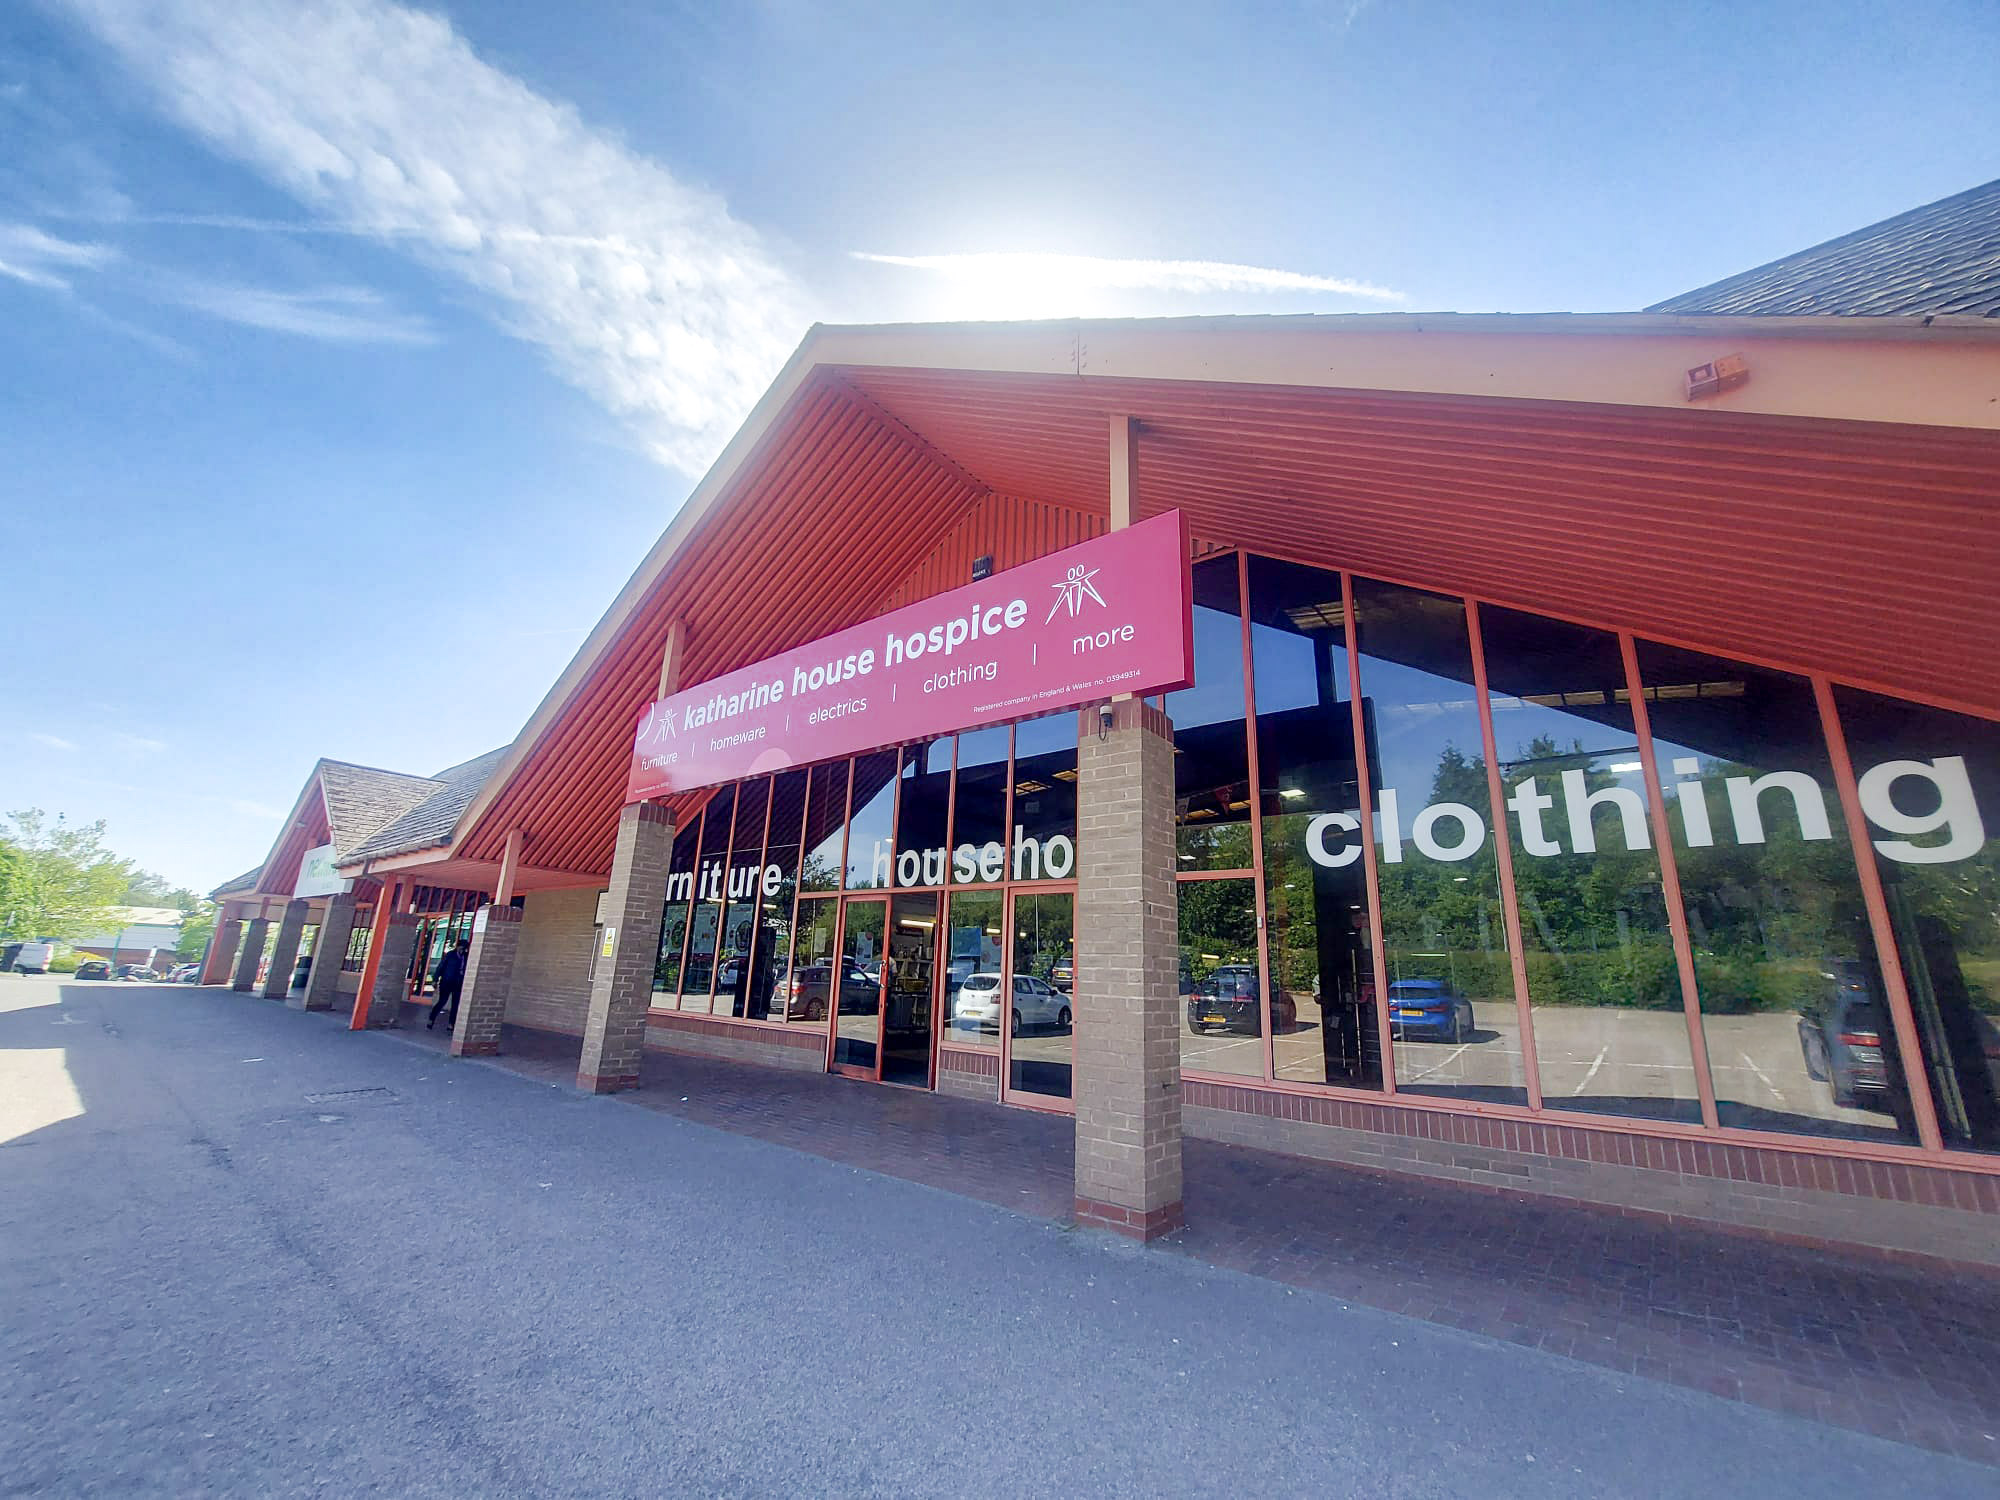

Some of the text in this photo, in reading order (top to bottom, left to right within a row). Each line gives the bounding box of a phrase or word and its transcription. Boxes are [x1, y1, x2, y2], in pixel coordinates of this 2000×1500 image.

[641, 624, 1135, 772] furniture homeware electrics clothing more
[683, 598, 1028, 731] katharine house hospice
[973, 701, 1003, 713] Registered
[1003, 695, 1031, 706] company
[1039, 686, 1065, 699] England
[1072, 680, 1092, 691] Wales
[666, 756, 1986, 901] rniture househo clothing
